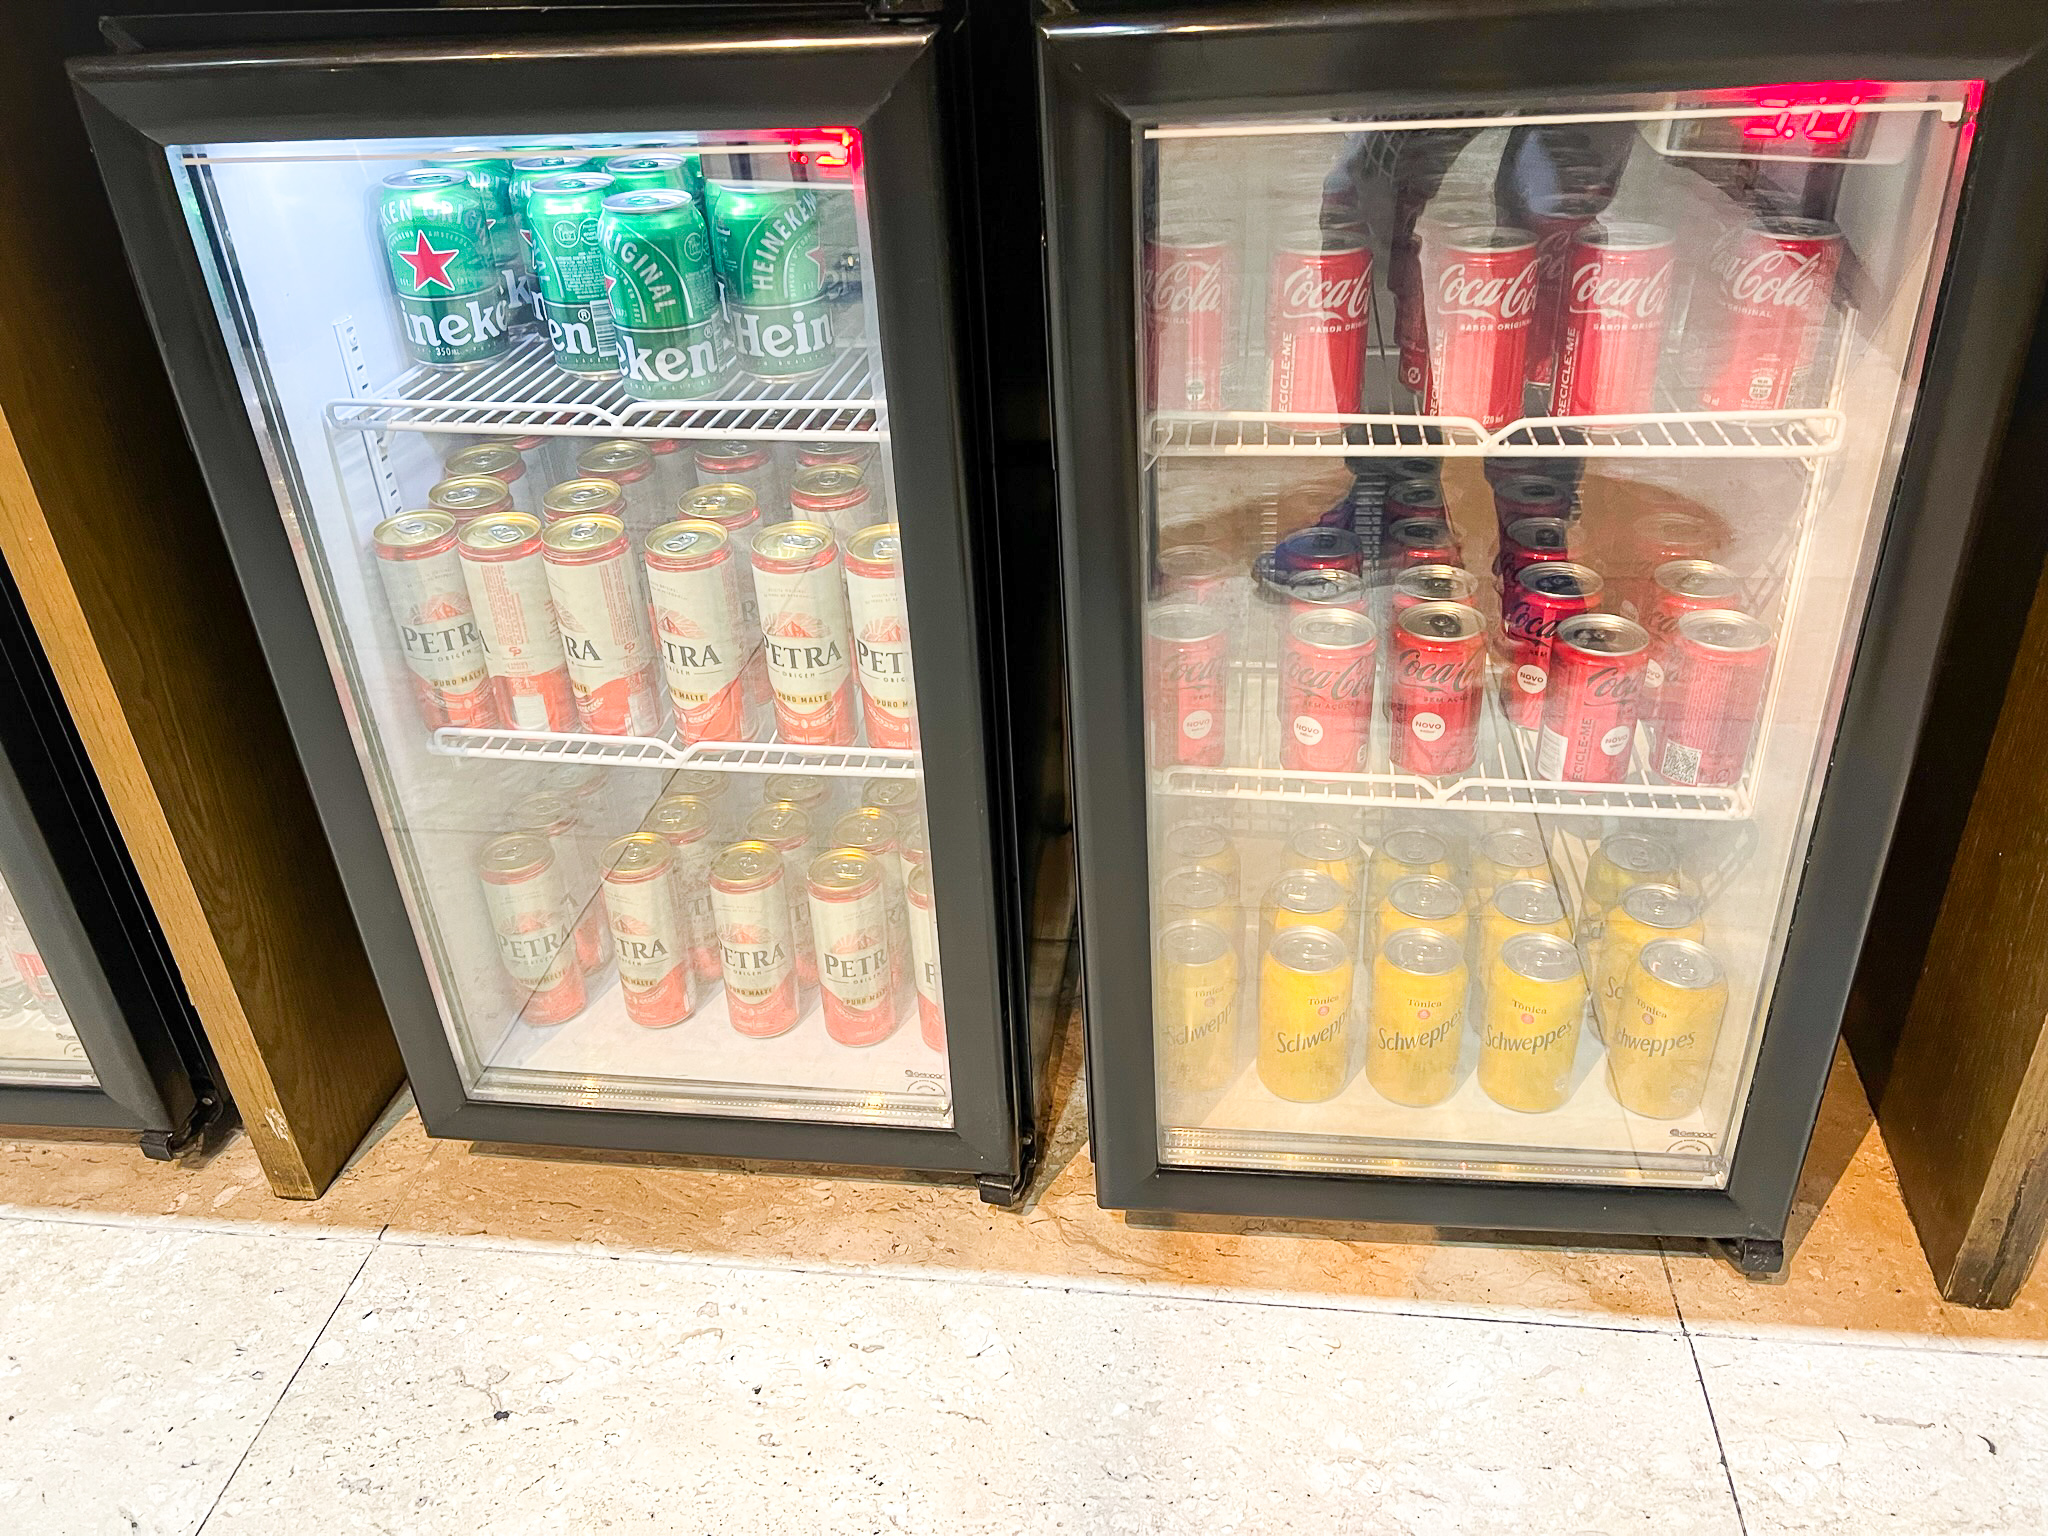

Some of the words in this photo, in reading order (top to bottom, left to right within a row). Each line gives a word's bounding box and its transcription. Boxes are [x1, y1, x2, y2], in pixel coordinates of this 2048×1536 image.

[752, 190, 818, 291] HEINEKEN
[732, 310, 834, 358] Hein
[663, 640, 723, 669] TRA
[1519, 671, 1544, 683] NOVO
[1296, 722, 1320, 735] NOVO
[1415, 721, 1442, 730] NOVO
[1605, 734, 1629, 744] NOVO
[616, 938, 669, 959] TRA
[1378, 1007, 1463, 1051] Schweppes
[1484, 1018, 1573, 1055] Schweppes
